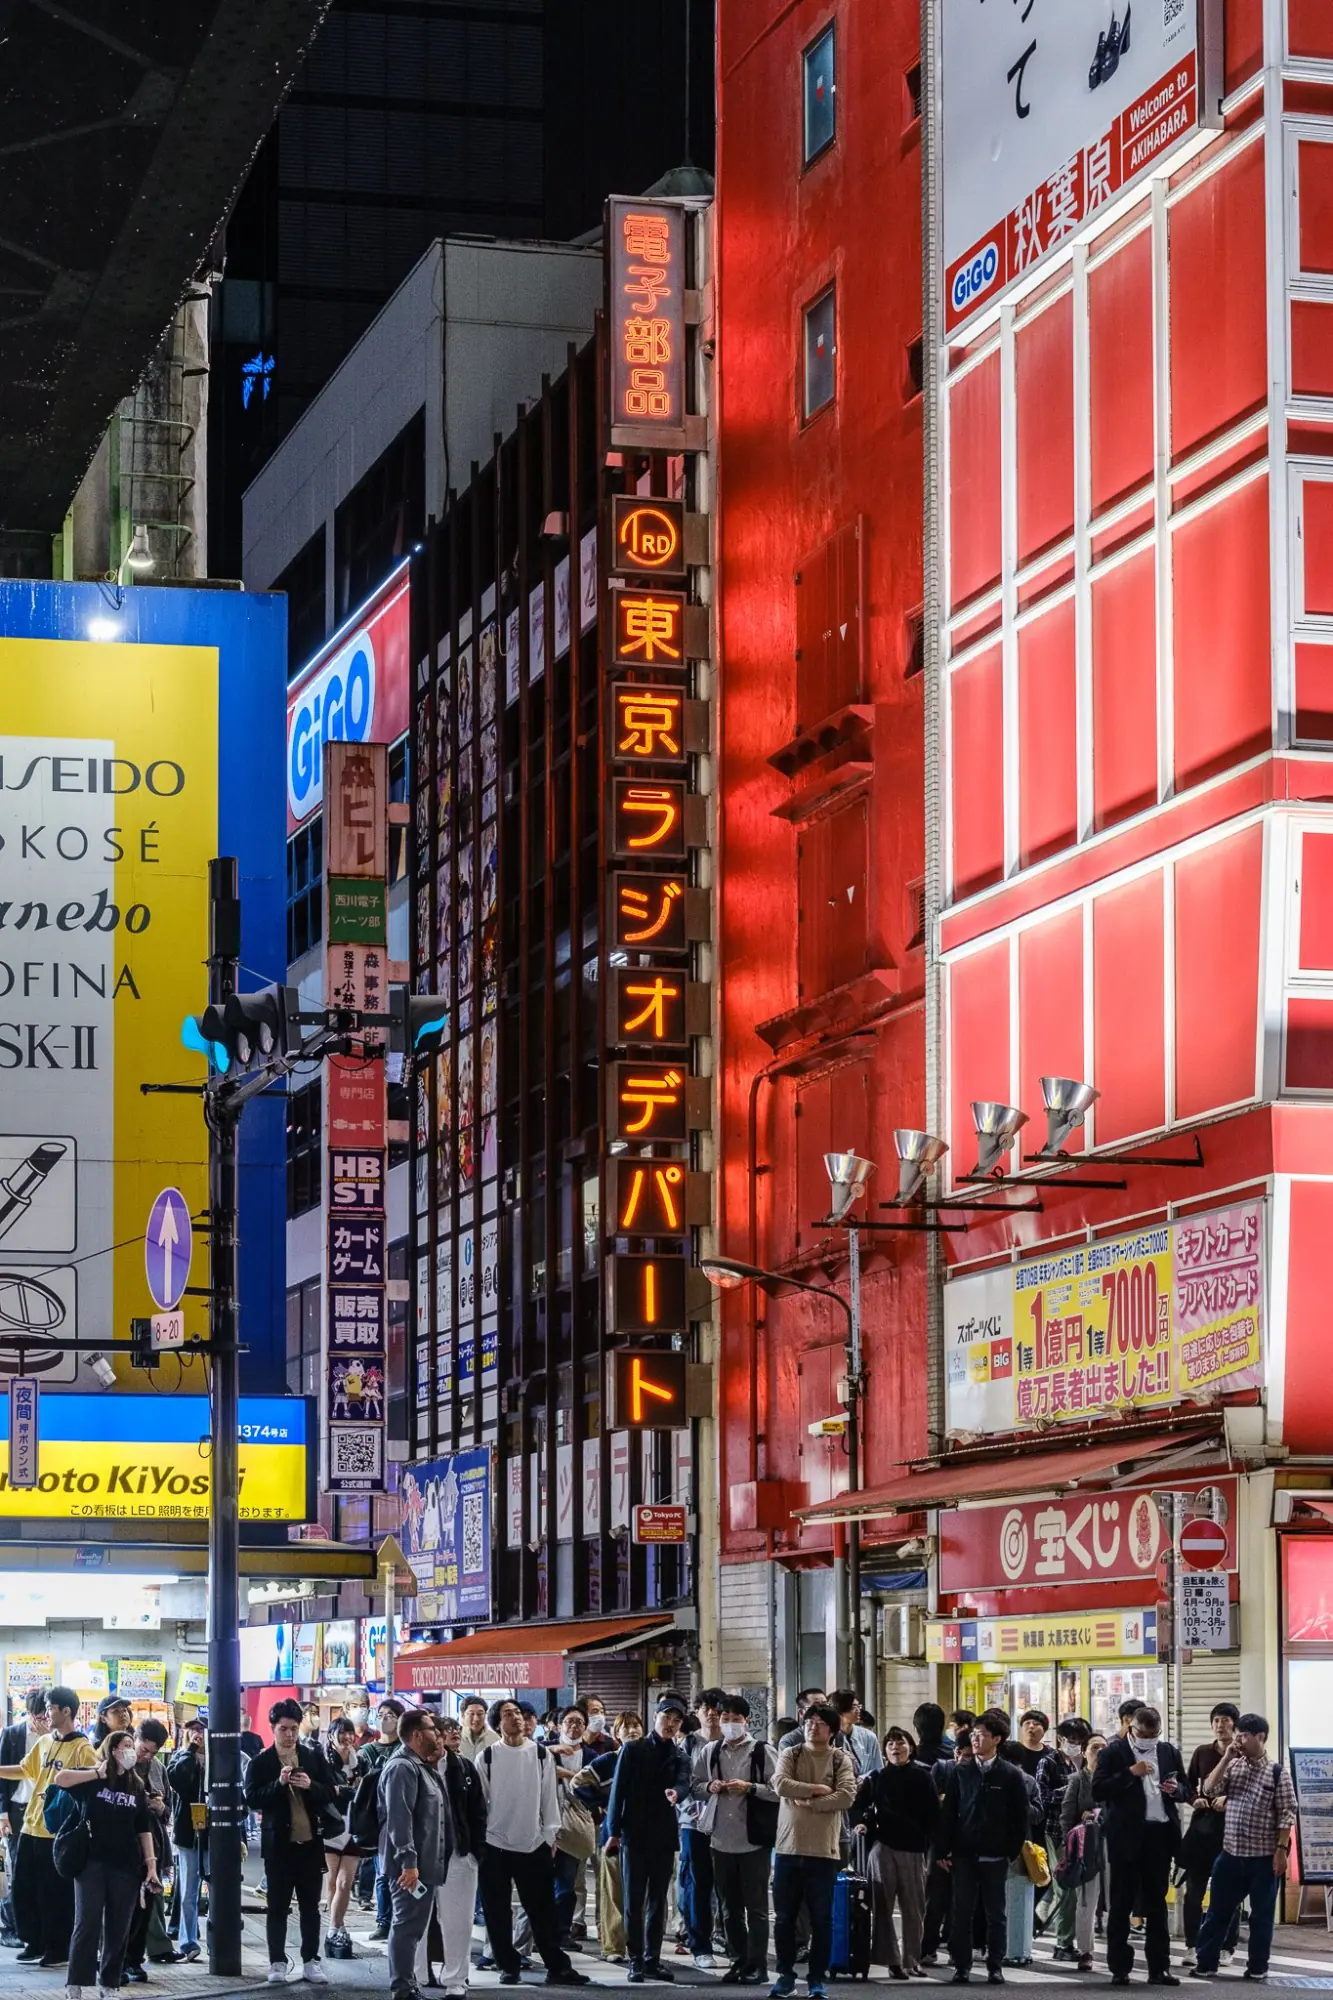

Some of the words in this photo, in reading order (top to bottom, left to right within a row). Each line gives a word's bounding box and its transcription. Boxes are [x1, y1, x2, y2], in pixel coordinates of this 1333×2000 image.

[1006, 0, 1037, 119] て
[1129, 82, 1174, 132] Welcome
[1177, 70, 1188, 90] to
[1130, 104, 1188, 170] AKIHABARA
[1014, 138, 1113, 272] 秋葉原
[623, 214, 672, 416] 電子部品
[22, 821, 160, 863] KOSÉ
[334, 894, 380, 908] 西川電子
[363, 951, 381, 1030] 森事務
[619, 598, 681, 1422] 東京ラジオデパート
[334, 1155, 380, 1178] HB
[334, 1182, 380, 1204] ST
[333, 1227, 380, 1249] カード
[1177, 1215, 1257, 1265] ギフトカード
[333, 1252, 381, 1276] ゲーム
[334, 1295, 379, 1318] 販売
[1177, 1269, 1257, 1319] プリペイドカード
[155, 1319, 180, 1342] 8-20
[334, 1322, 379, 1345] 買取
[957, 1315, 1002, 1345] スポーツくじ
[16, 1386, 32, 1421] 夜間
[18, 1423, 29, 1479] 押ボタン式
[107, 1465, 247, 1494] KiYosi
[70, 1505, 127, 1518] この看板は
[131, 1505, 155, 1517] LED
[158, 1504, 290, 1519] 照明を使用おります。
[653, 1511, 674, 1519] Tokyo
[1033, 1499, 1121, 1576] 宝くじ
[1182, 1576, 1225, 1586] 自転車を除く
[1023, 1630, 1045, 1649] 秋葉原
[412, 1666, 434, 1688] TOKYO
[435, 1664, 456, 1687] RADIO
[456, 1663, 503, 1686] DEPARTMENT
[504, 1662, 530, 1685] STORE
